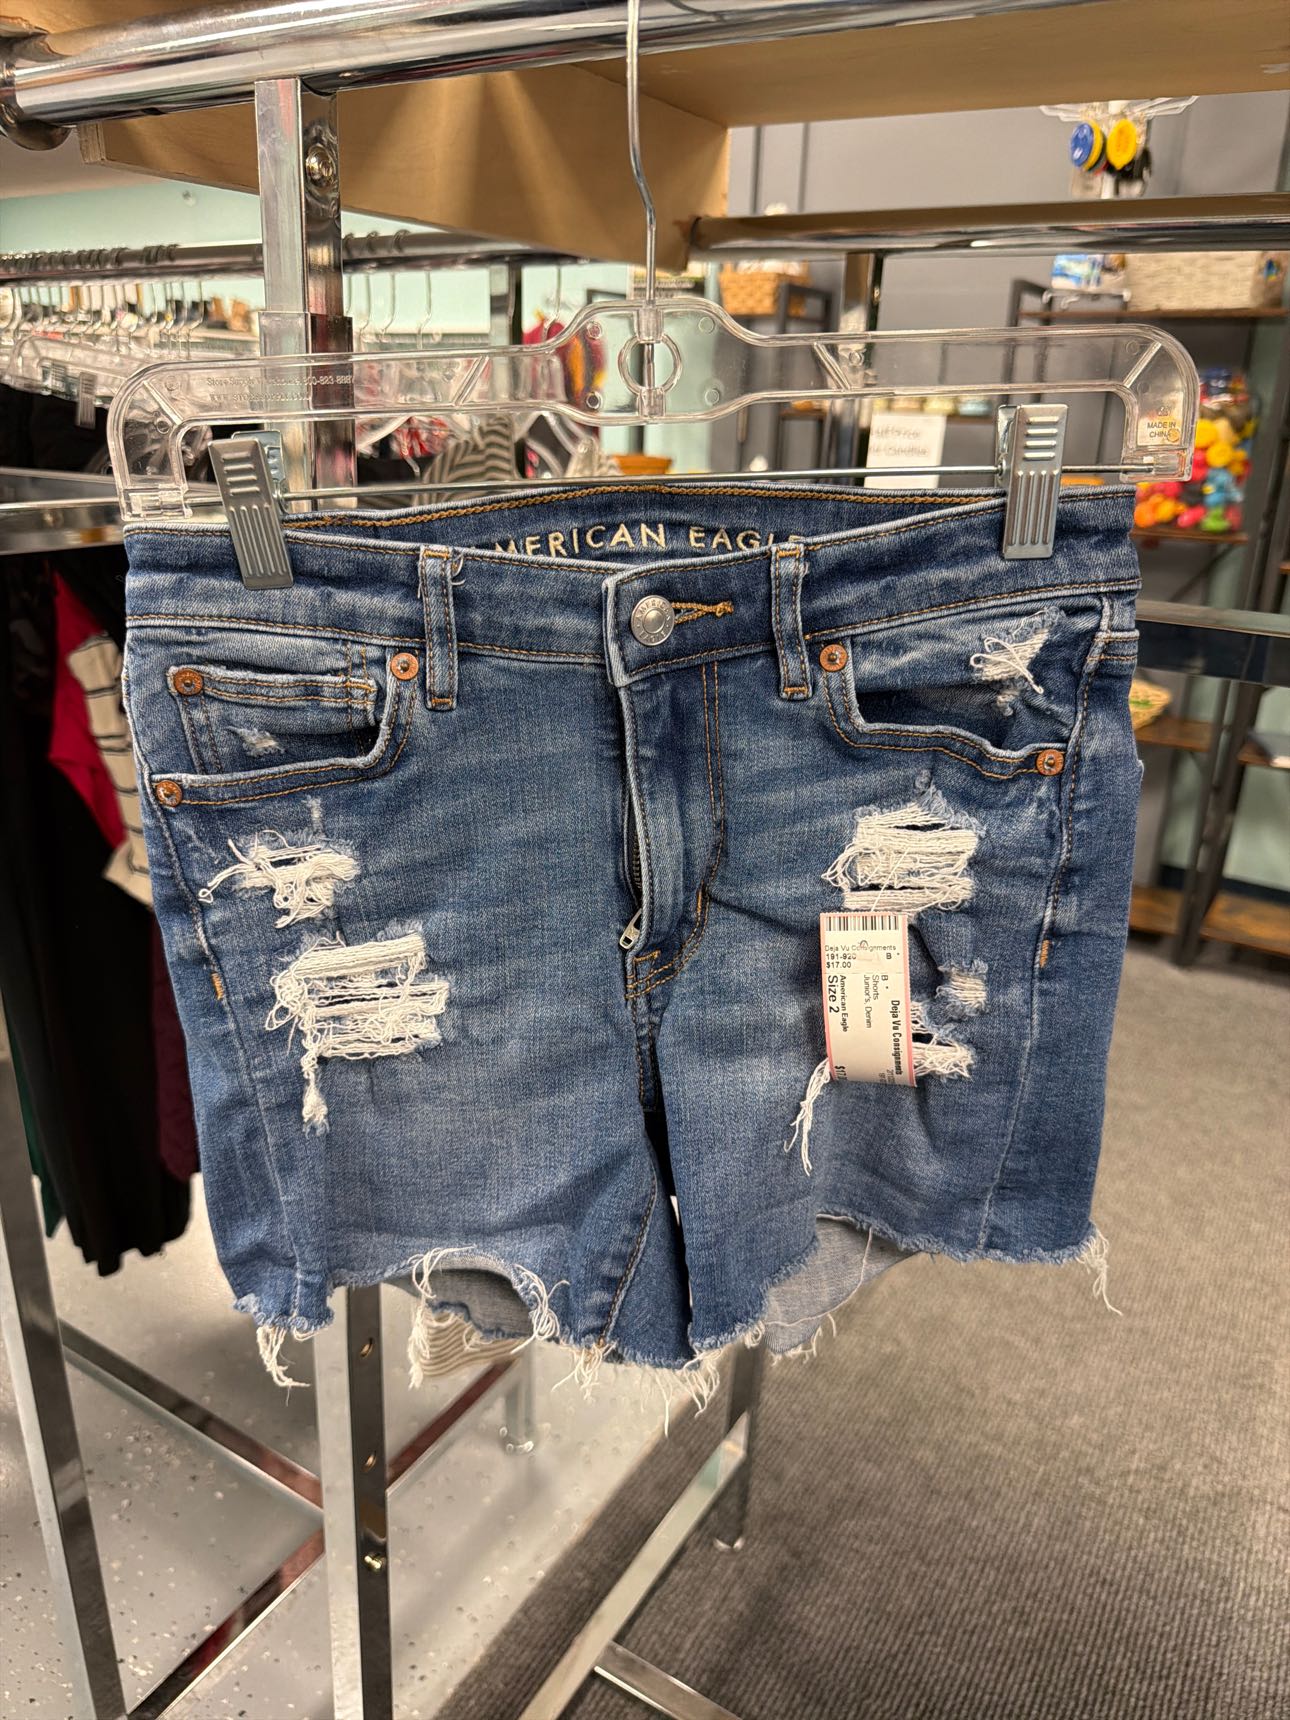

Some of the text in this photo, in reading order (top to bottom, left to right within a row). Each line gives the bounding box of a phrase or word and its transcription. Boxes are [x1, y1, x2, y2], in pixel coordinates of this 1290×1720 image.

[1147, 421, 1168, 429] MADE
[826, 961, 852, 969] $17.00
[828, 975, 838, 1002] Size
[864, 1006, 872, 1028] Denim
[889, 1000, 900, 1018] Deja
[840, 1013, 849, 1032] Eagle
[892, 1020, 901, 1031] Vu
